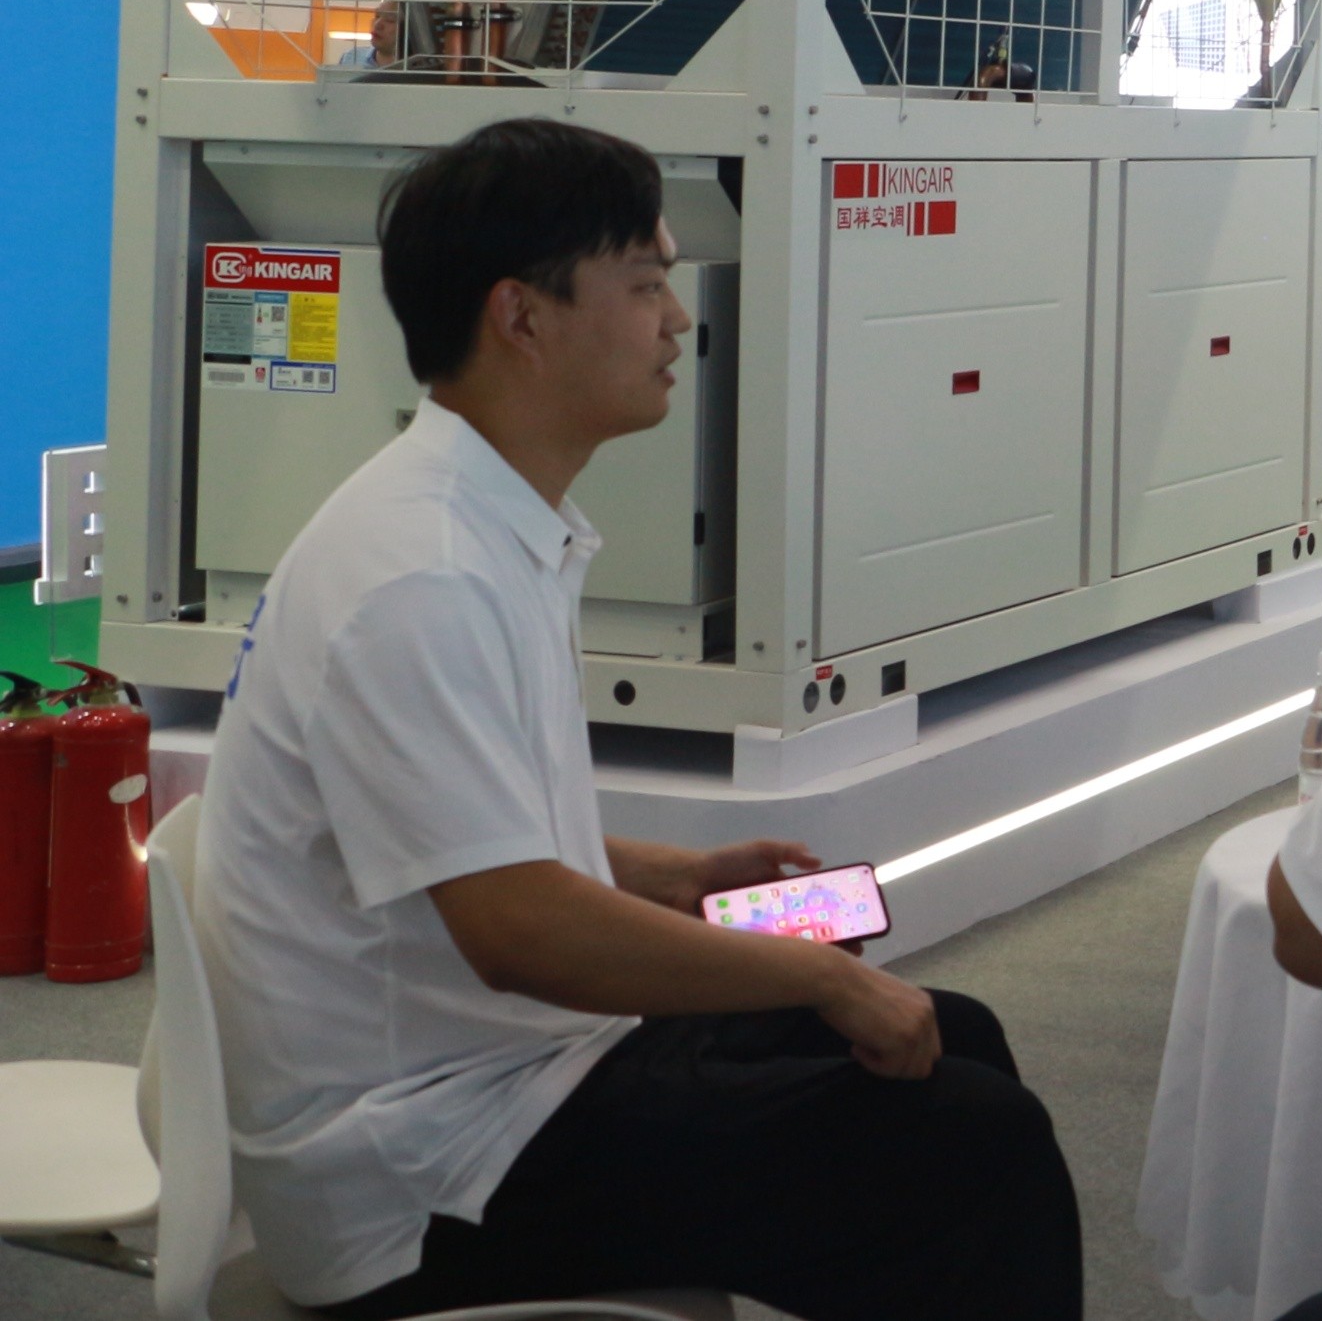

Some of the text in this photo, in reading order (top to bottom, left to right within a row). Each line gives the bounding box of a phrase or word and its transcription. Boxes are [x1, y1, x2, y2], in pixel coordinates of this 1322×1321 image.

[888, 167, 954, 194] KINGAIR
[837, 206, 905, 229] 国祥空调
[254, 261, 333, 281] KINGAIR
